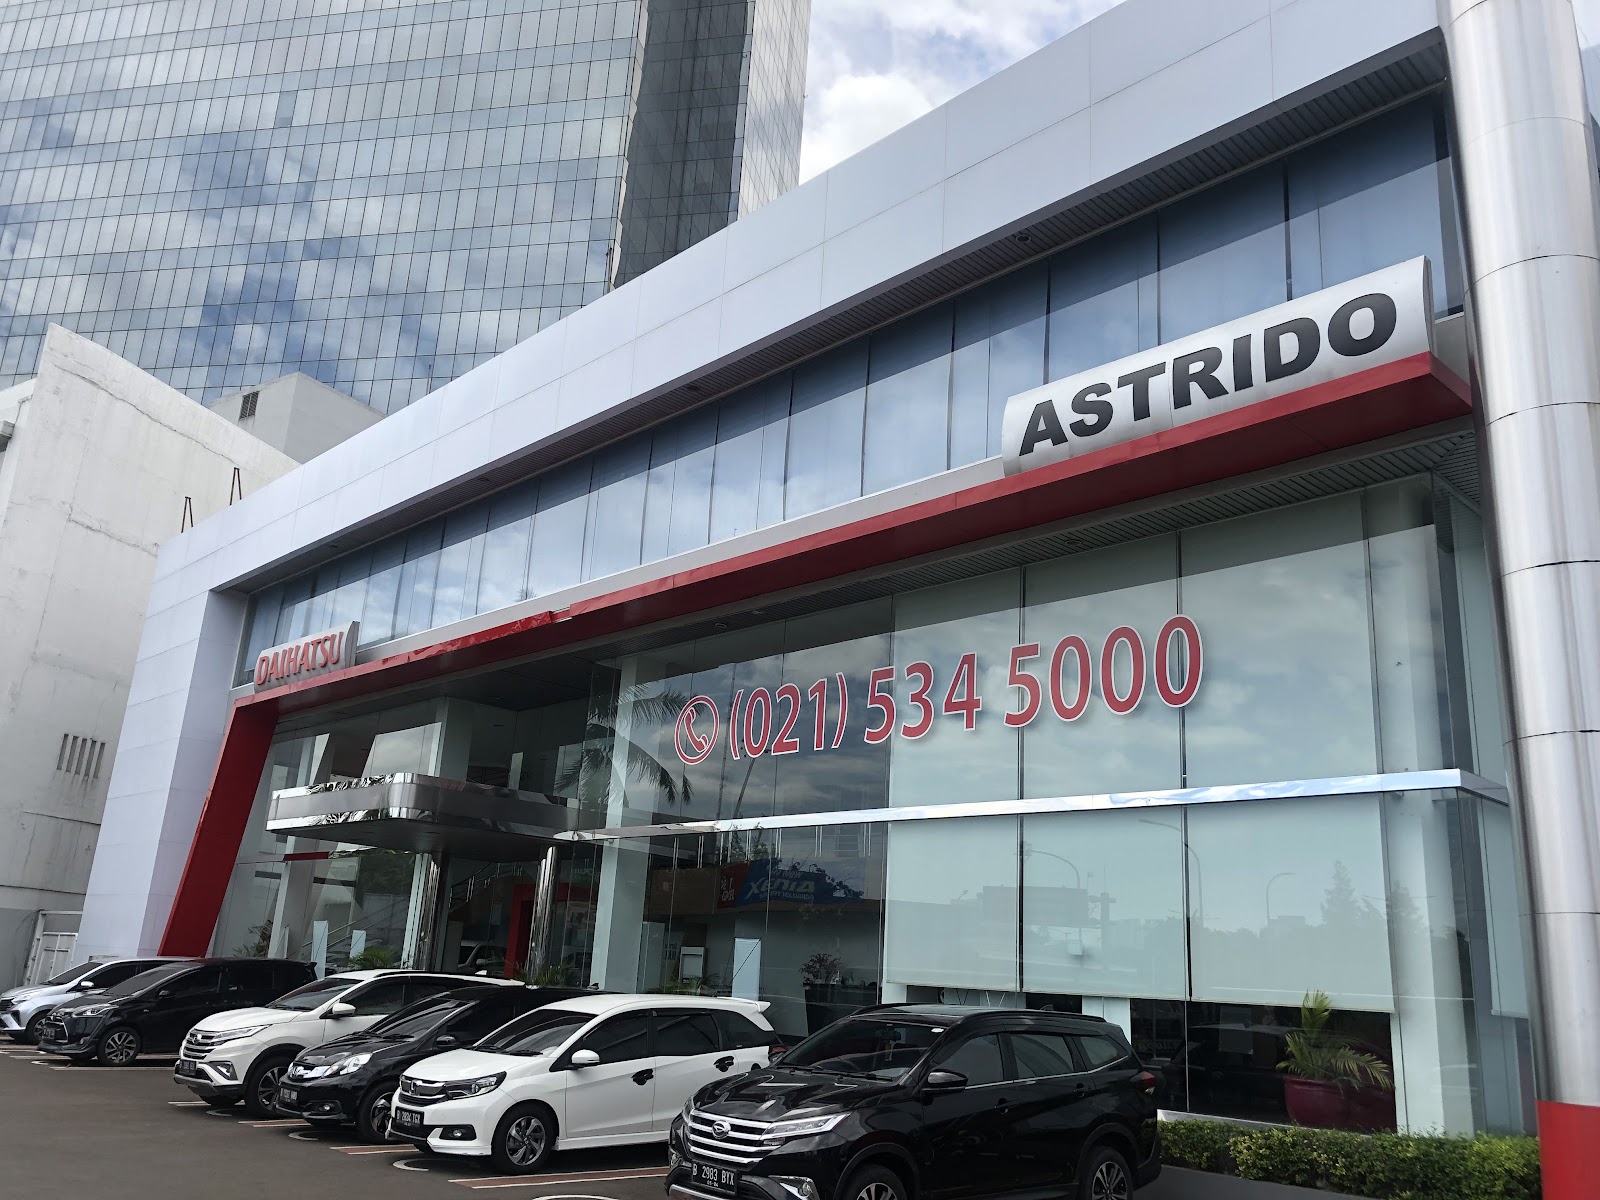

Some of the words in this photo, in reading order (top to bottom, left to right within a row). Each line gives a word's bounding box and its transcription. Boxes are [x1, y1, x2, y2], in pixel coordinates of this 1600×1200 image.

[1019, 292, 1397, 456] ASTRIDO
[256, 631, 344, 685] DAIHATSU
[730, 672, 848, 761] (021)
[864, 651, 982, 744] 534
[1003, 614, 1203, 728] 5000
[692, 1163, 698, 1176] B
[701, 1165, 718, 1181] 2983
[721, 1169, 735, 1186] BTX
